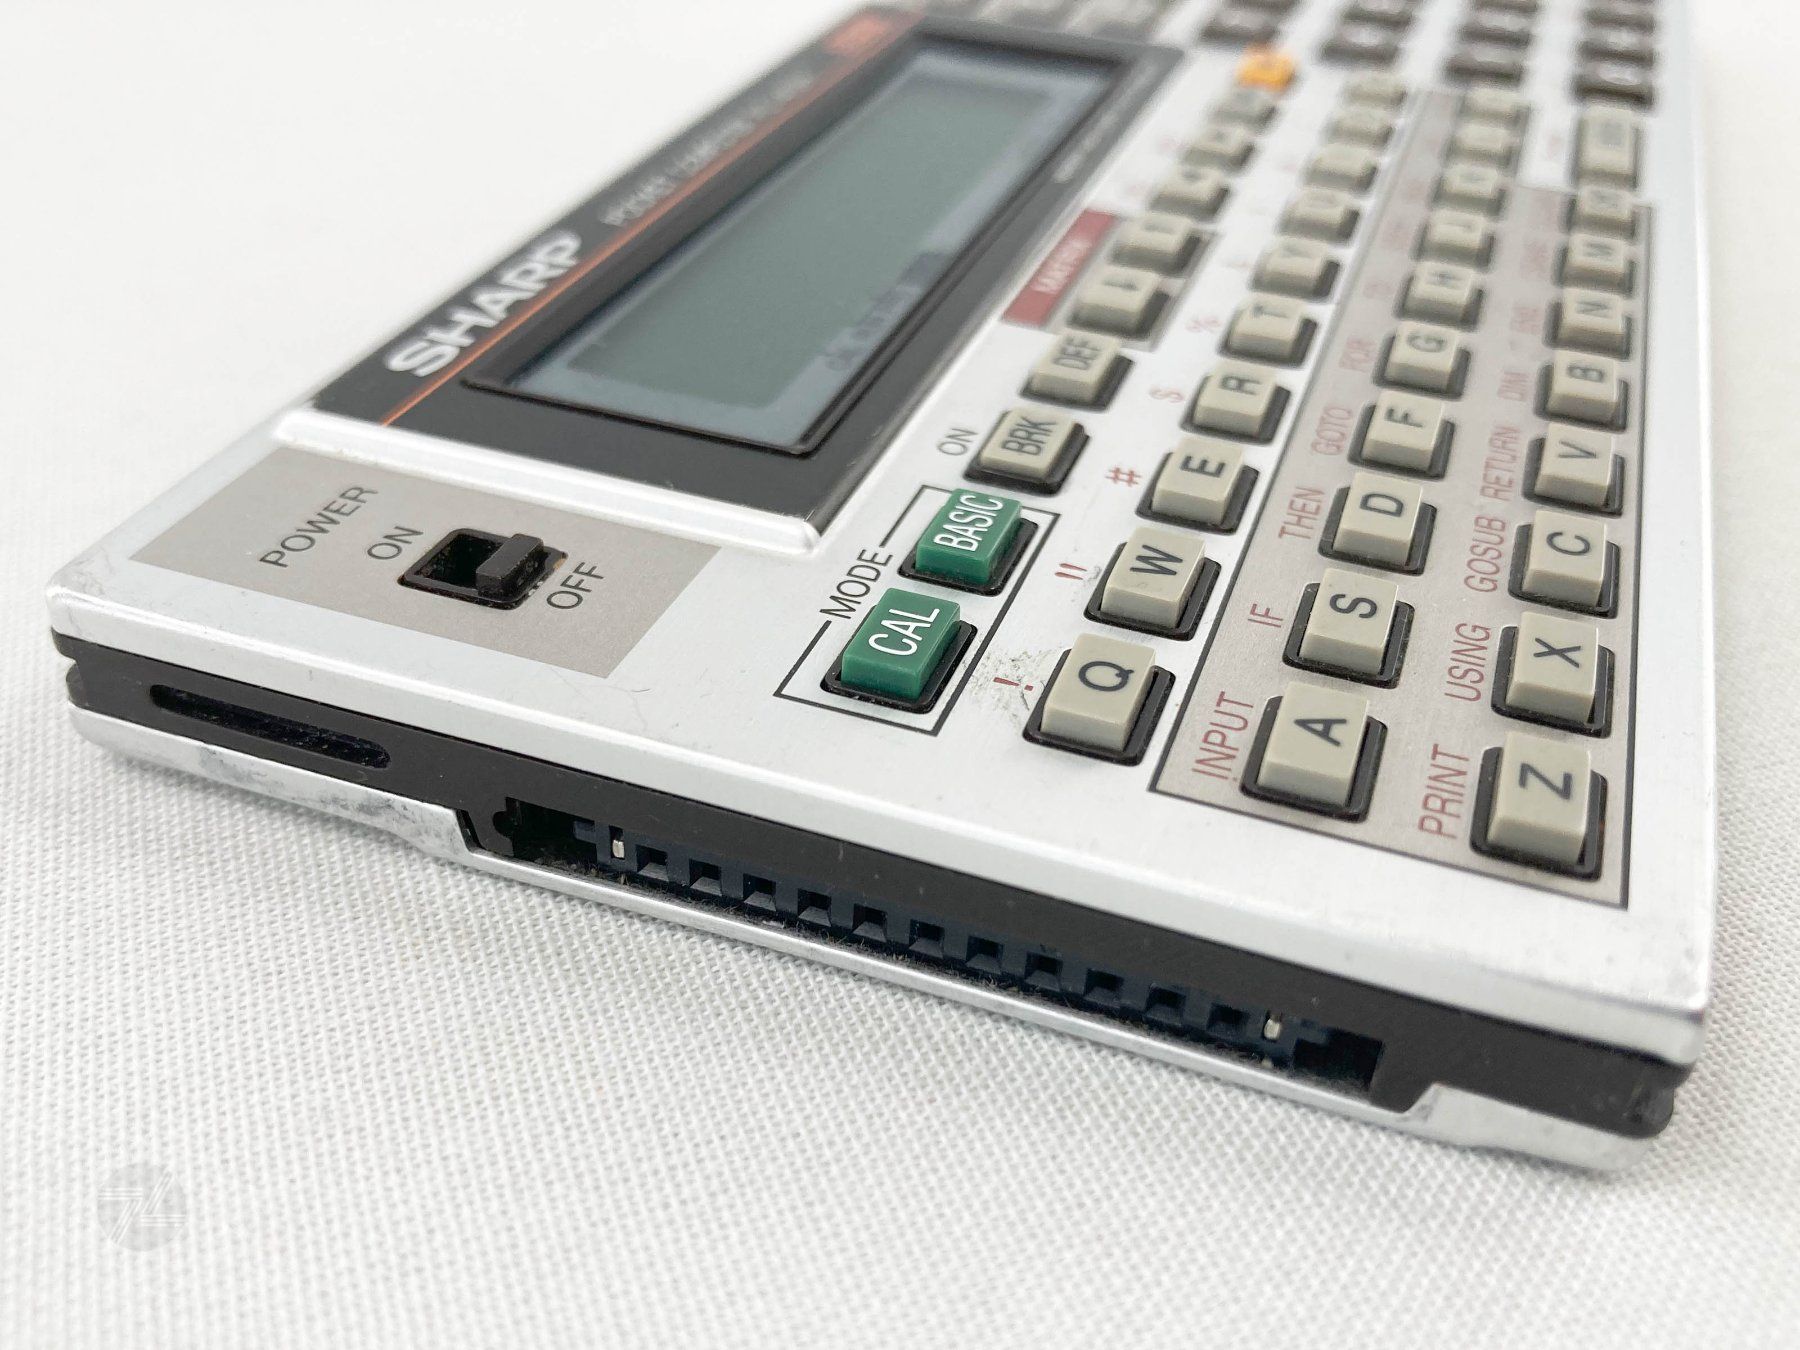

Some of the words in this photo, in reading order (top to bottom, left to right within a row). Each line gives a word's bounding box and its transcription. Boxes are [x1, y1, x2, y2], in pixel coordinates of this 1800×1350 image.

[385, 232, 582, 377] SHARP
[1052, 337, 1101, 370] DEF
[1406, 332, 1447, 353] G
[1221, 374, 1264, 396] R
[1566, 363, 1606, 383] B
[1311, 406, 1351, 456] GOTO
[1385, 406, 1424, 428] F
[936, 427, 978, 456] ON
[1002, 415, 1057, 456] BRK
[1558, 440, 1598, 460] V
[1105, 466, 1143, 488] #
[1180, 453, 1227, 479] E
[1480, 424, 1522, 501] RETURN
[933, 493, 1004, 552] BASIC
[1278, 486, 1326, 540] THEN
[1359, 492, 1405, 519] D
[259, 485, 379, 569] POWER
[366, 525, 424, 561] ON
[1546, 531, 1592, 556] C
[1130, 544, 1184, 577] W
[1464, 515, 1507, 594] GOSUB
[546, 561, 605, 610] OFF
[819, 548, 893, 620] MODE
[1247, 602, 1284, 629] IF
[1329, 593, 1378, 619] S
[868, 607, 940, 657] CAL
[1445, 622, 1492, 702] USING
[1533, 637, 1582, 669] X
[1078, 659, 1134, 693] Q
[1192, 691, 1254, 781] INPUT
[1294, 716, 1348, 747] A
[1418, 743, 1470, 840] PRINT
[1518, 762, 1573, 800] Z
